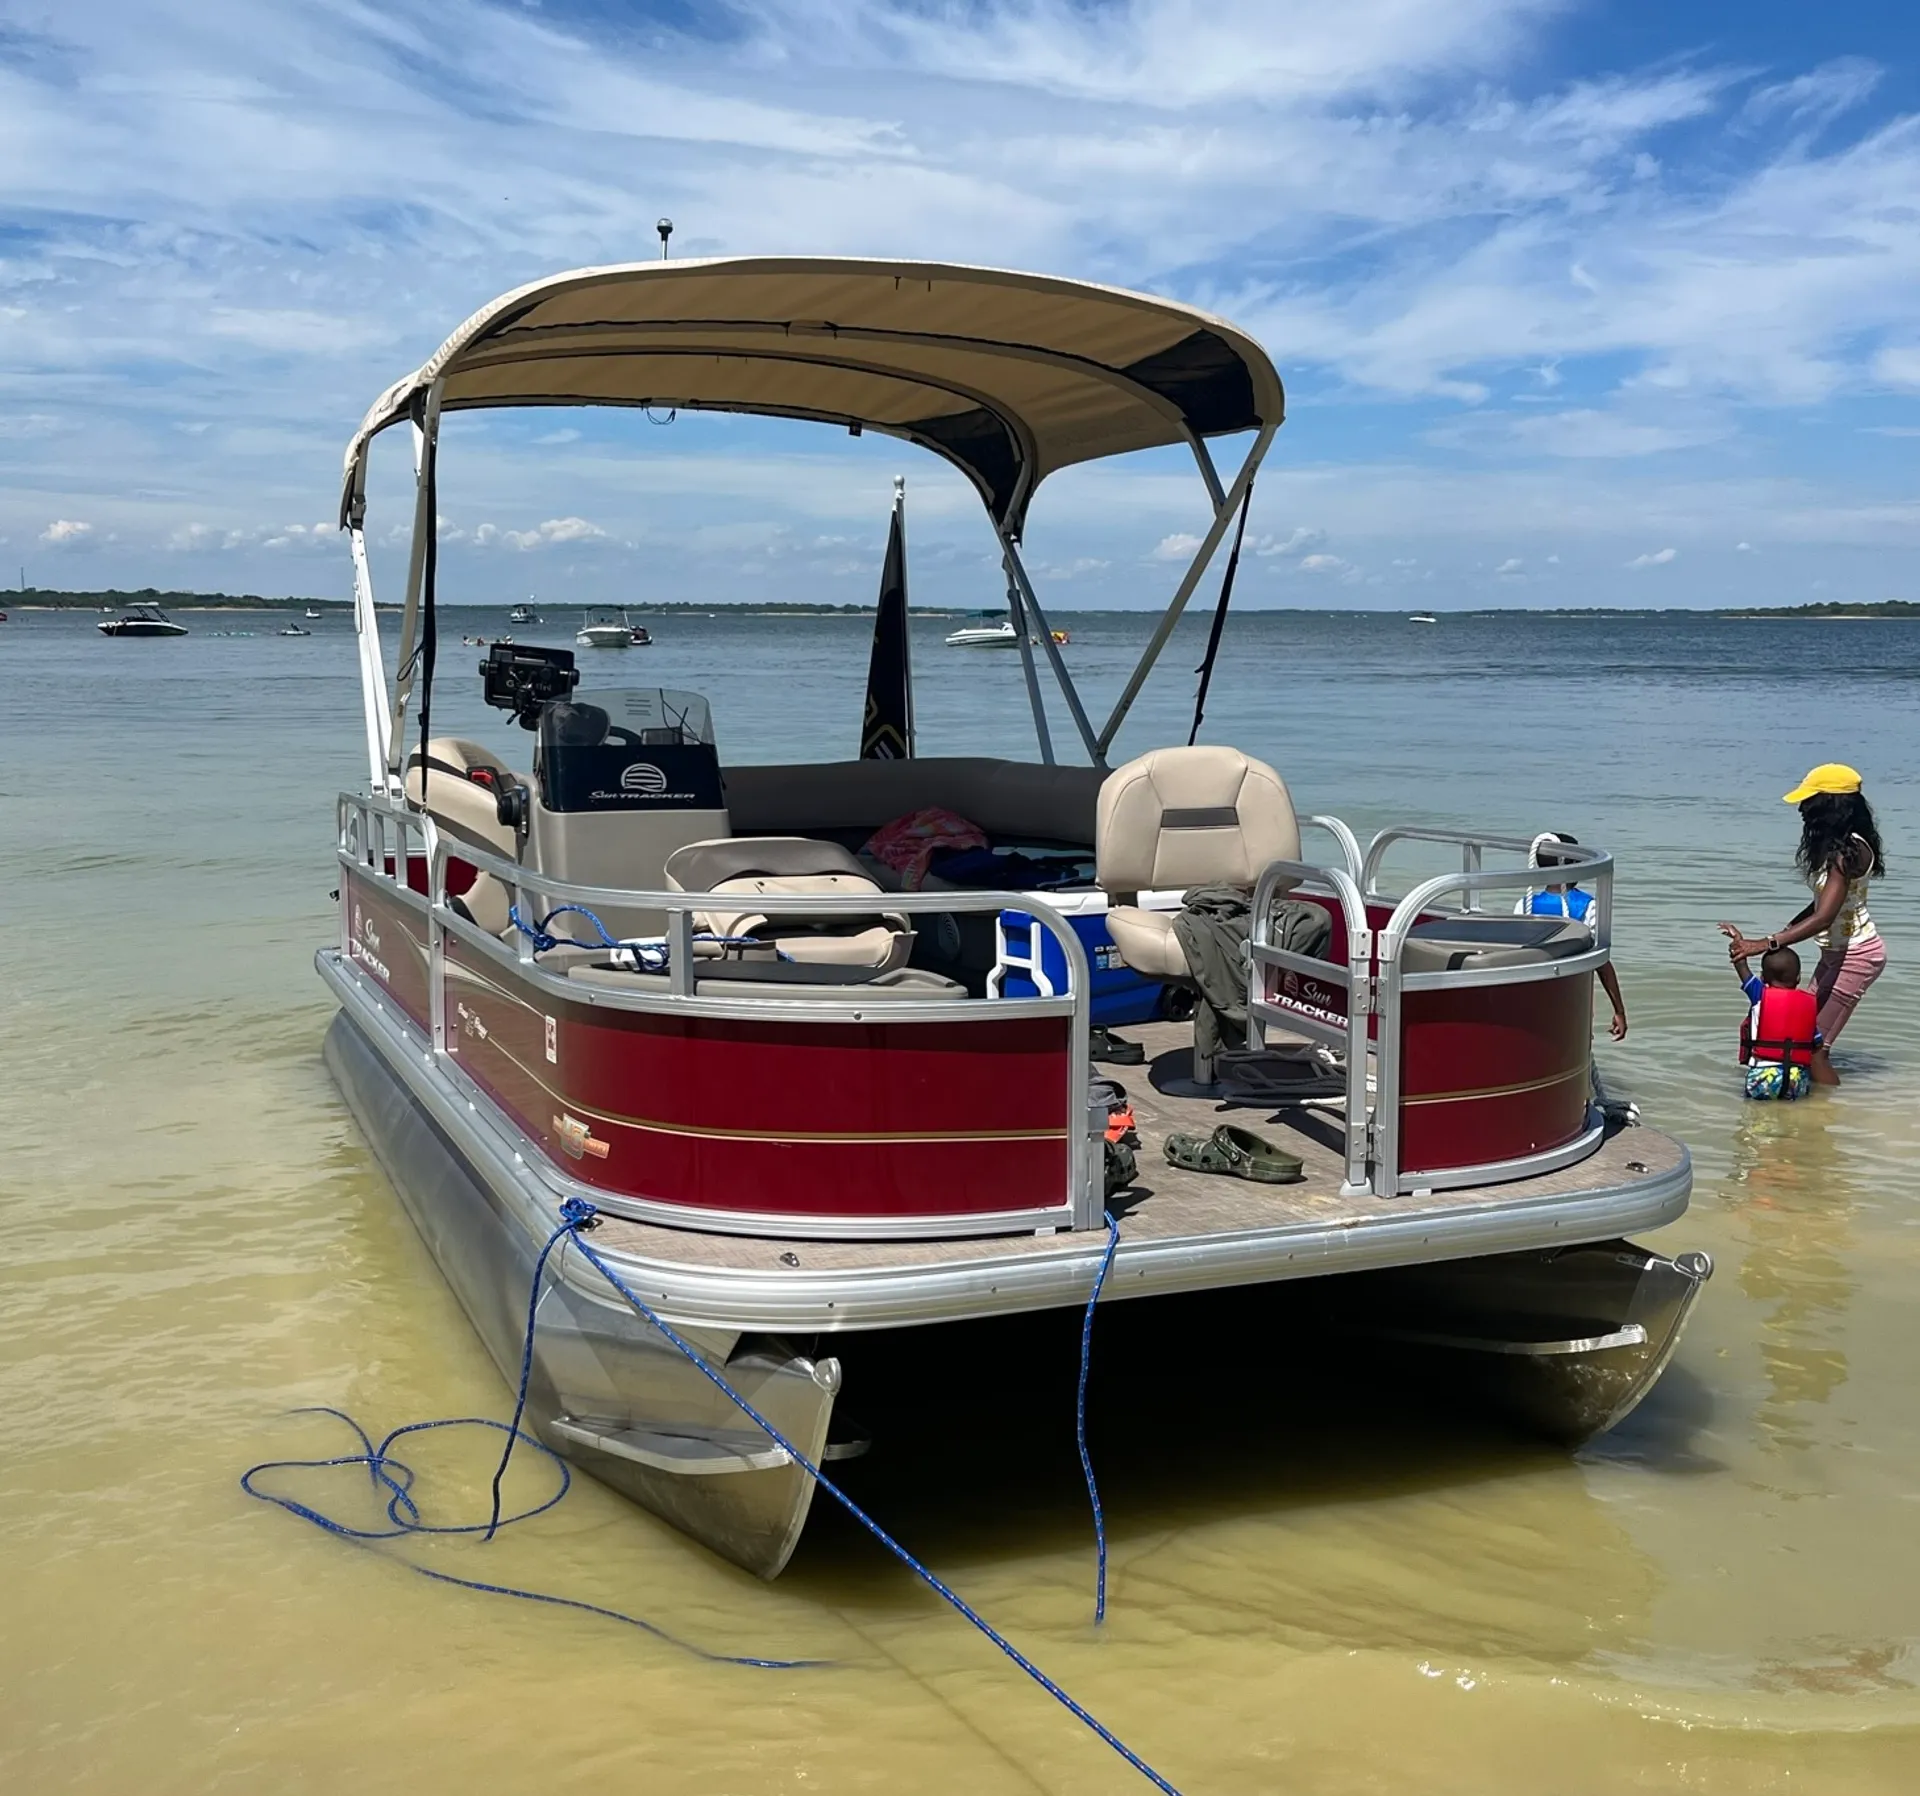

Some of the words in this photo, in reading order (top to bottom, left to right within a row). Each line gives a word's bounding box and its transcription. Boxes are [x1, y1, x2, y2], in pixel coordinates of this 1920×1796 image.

[588, 790, 618, 799] Sun
[349, 937, 390, 985] TRACKER
[1299, 981, 1333, 1007] Sun
[1273, 992, 1348, 1027] TRACKER
